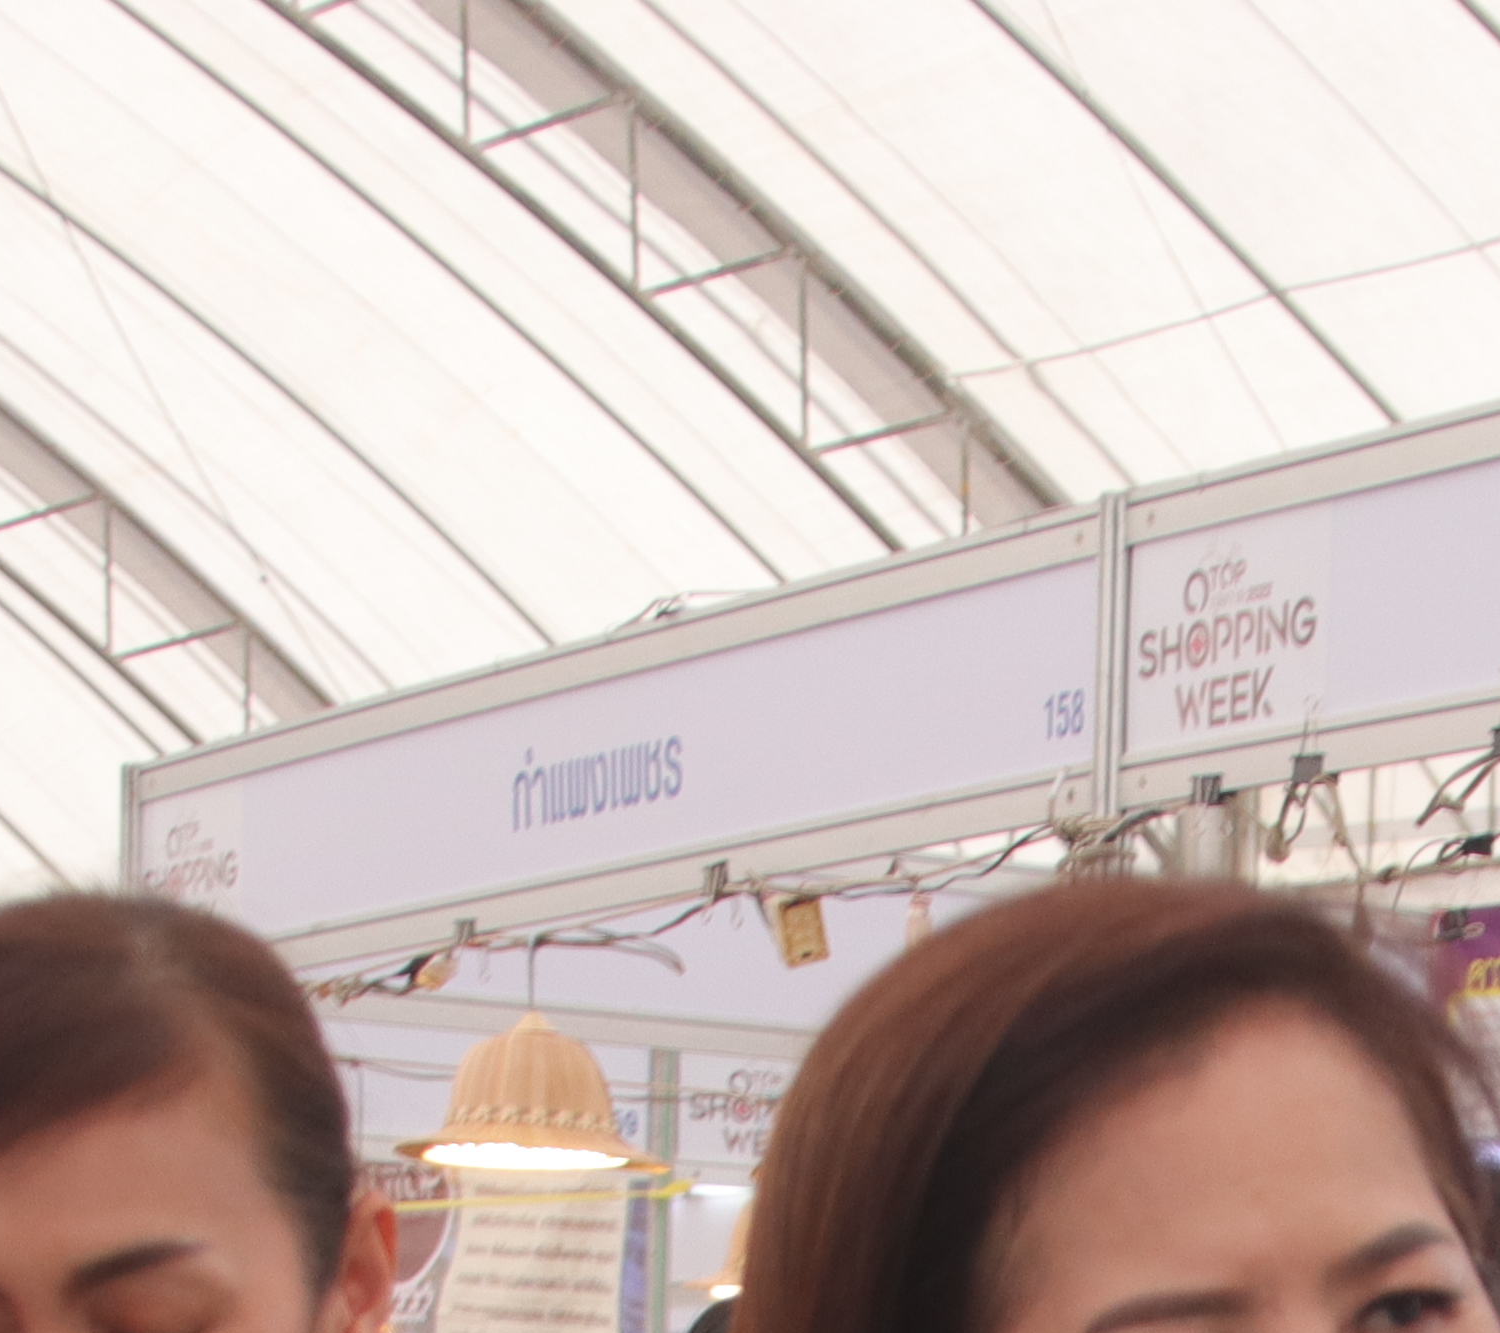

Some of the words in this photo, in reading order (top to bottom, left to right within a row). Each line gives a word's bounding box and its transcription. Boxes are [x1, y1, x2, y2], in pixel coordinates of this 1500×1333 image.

[1138, 595, 1318, 681] SHOPPING
[1044, 688, 1086, 741] 158
[1174, 665, 1274, 732] WEEK
[512, 734, 683, 834] กำแพงเพชร
